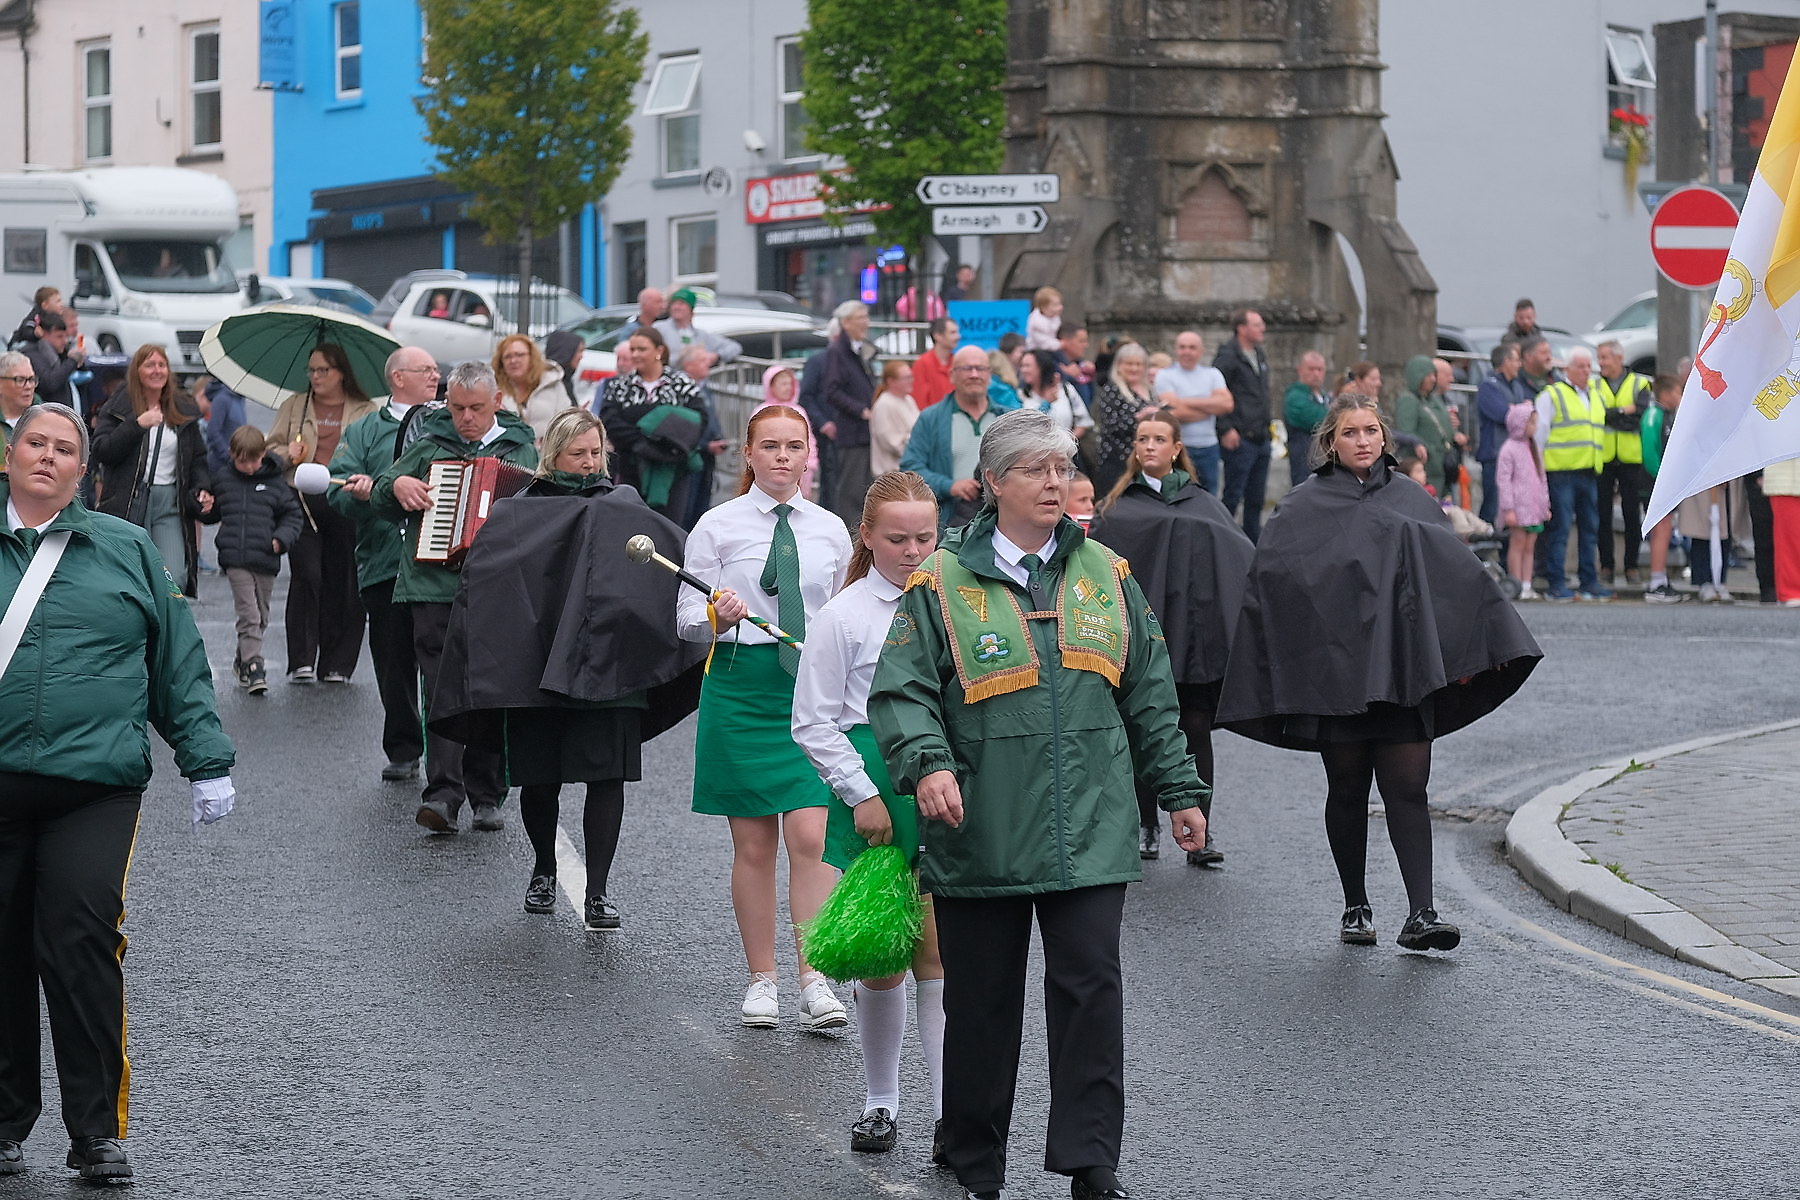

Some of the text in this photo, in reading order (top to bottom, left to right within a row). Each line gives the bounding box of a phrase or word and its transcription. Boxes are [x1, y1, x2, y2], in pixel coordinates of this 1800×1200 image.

[938, 181, 1052, 198] C'blayney 10
[940, 212, 1027, 228] Armagh 8
